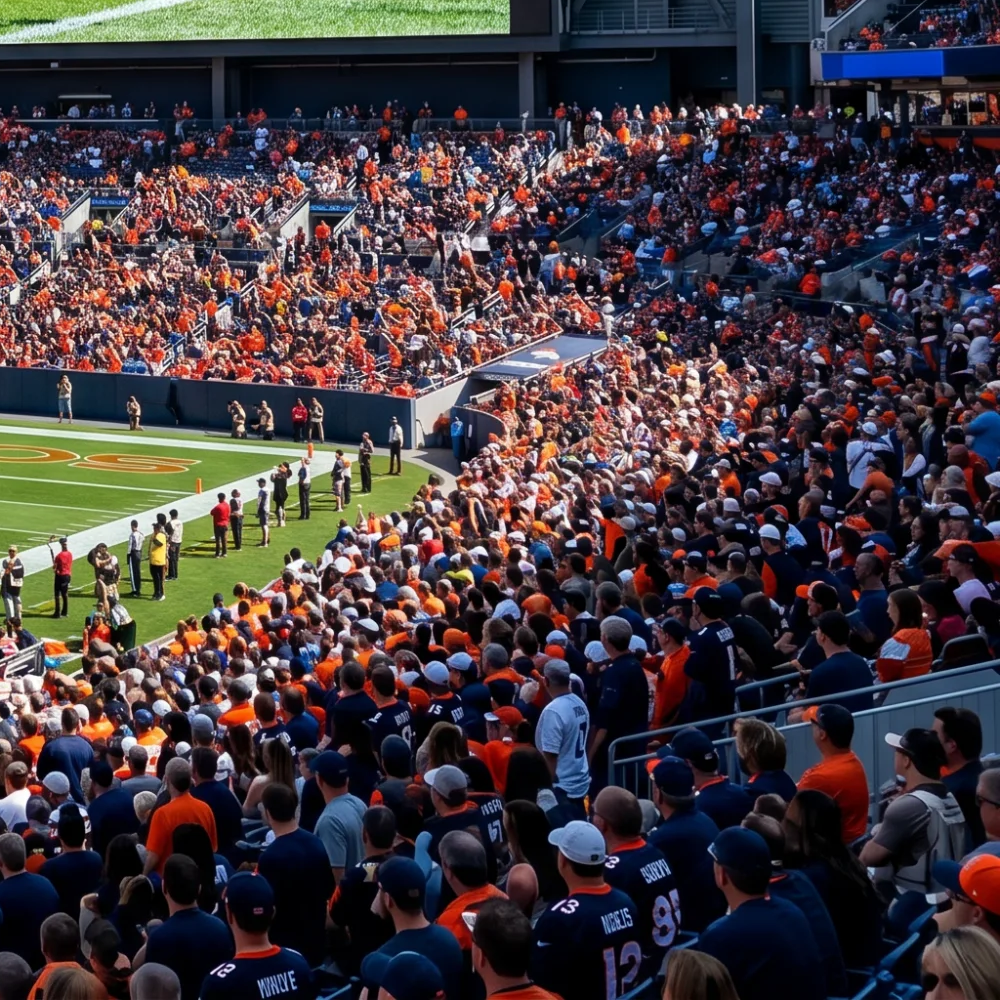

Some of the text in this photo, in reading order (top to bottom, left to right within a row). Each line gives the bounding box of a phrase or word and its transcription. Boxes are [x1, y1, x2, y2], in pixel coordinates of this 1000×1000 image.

[551, 899, 580, 914] 13
[210, 962, 236, 978] 12
[603, 941, 641, 1000] 12
